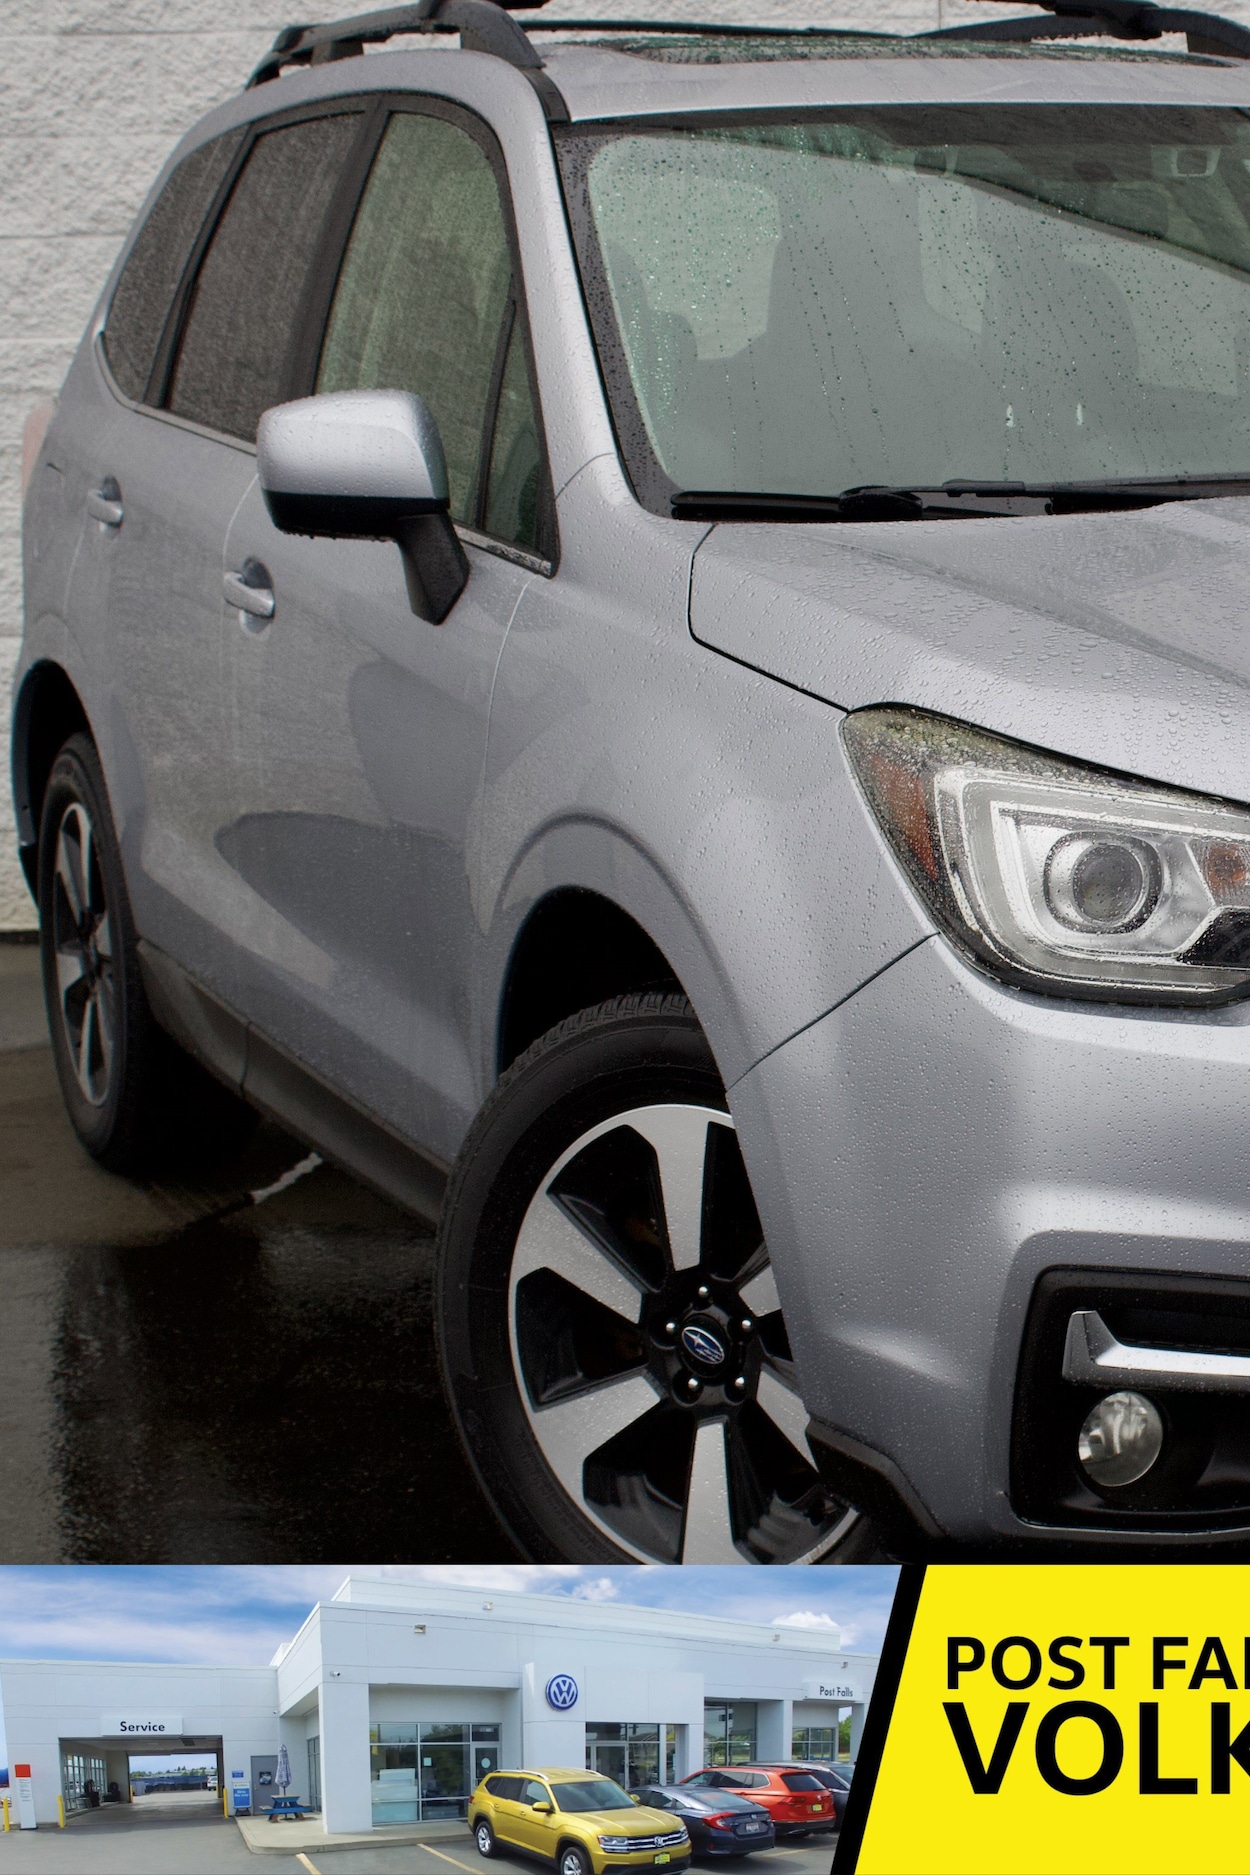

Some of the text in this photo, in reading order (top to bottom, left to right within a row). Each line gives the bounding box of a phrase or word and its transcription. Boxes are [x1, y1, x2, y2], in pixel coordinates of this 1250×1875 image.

[819, 1686, 853, 1697] Post Falls
[120, 1721, 165, 1732] Service
